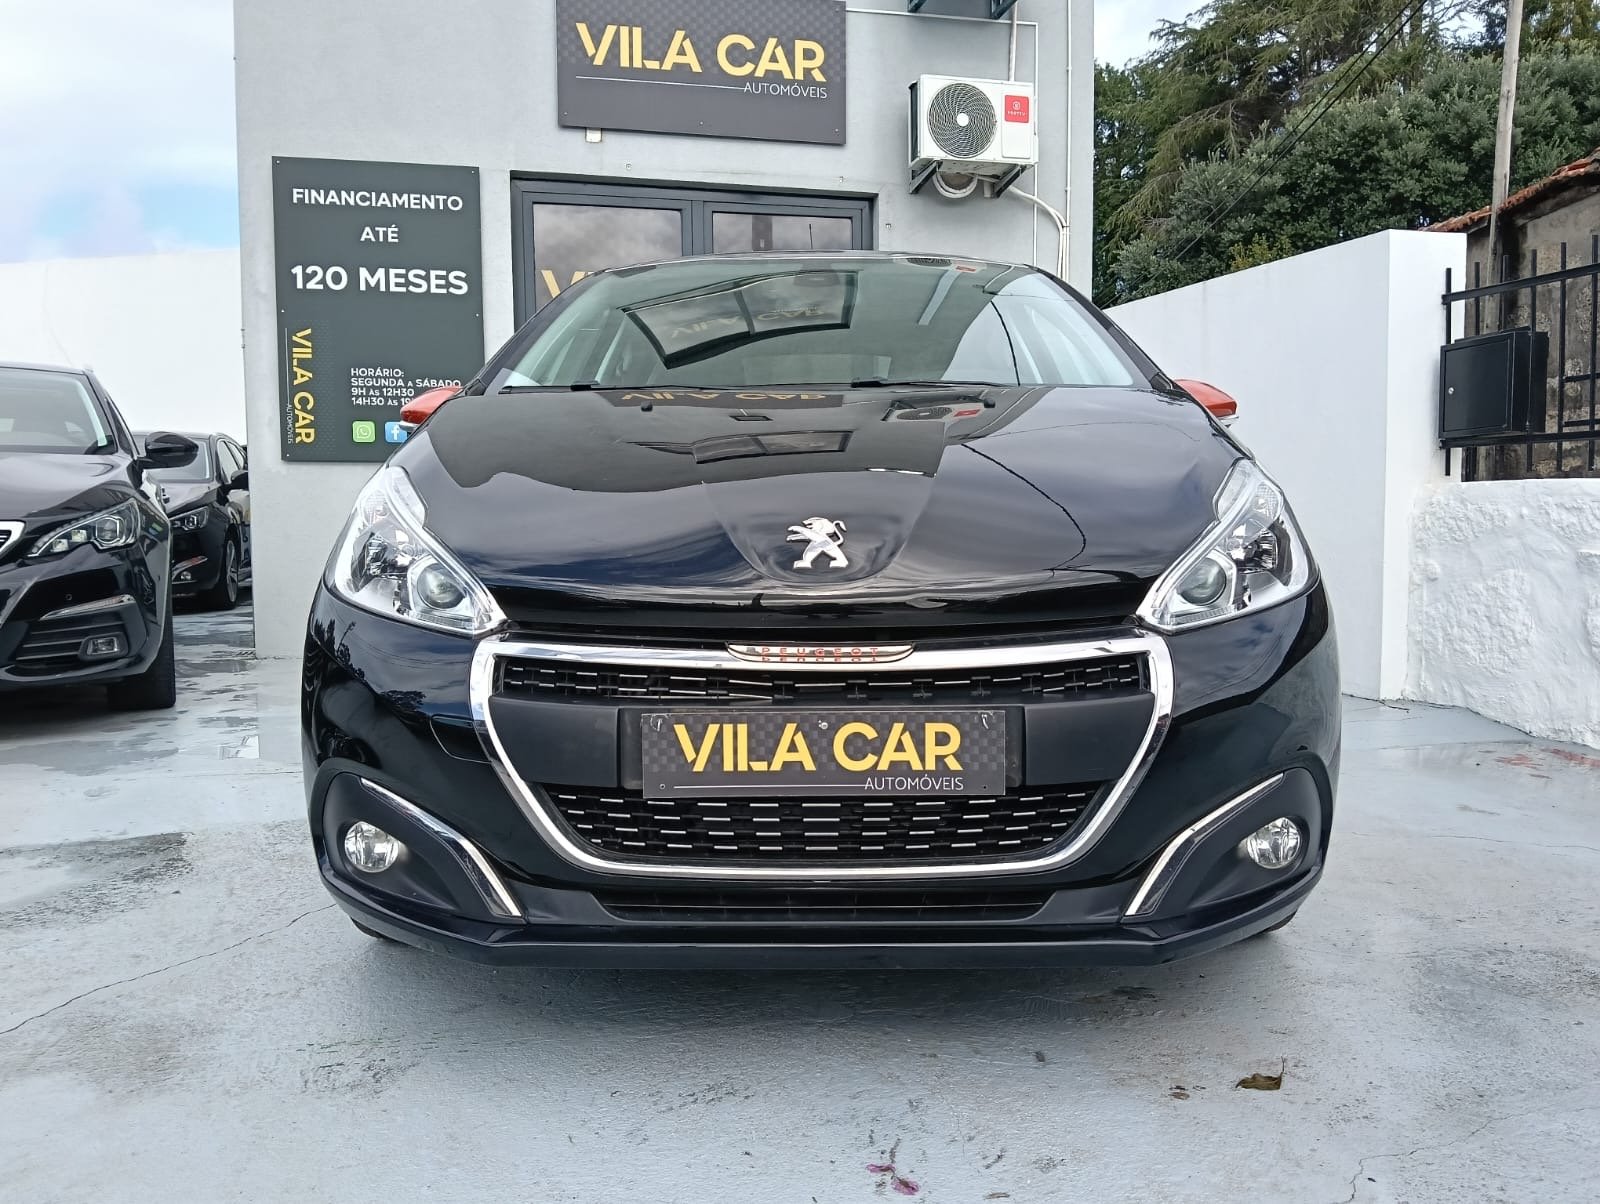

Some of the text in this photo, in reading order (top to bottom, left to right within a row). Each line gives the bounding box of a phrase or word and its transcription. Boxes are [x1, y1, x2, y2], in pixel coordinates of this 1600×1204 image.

[575, 22, 827, 82] VILA CAR
[744, 82, 828, 99] AUTOMÓVEIS
[291, 188, 464, 211] FINANCIAMENTO
[360, 224, 400, 243] ATÉ
[290, 265, 469, 295] 120 MESES
[351, 367, 405, 377] HORÁRIO:
[292, 328, 315, 444] VILA CAR
[351, 378, 405, 387] SEGUNDA
[416, 378, 461, 388] SÁBADO
[351, 388, 366, 396] 9H
[383, 388, 415, 397] 12H30
[351, 397, 385, 406] 14H30
[761, 647, 879, 656] PEUGEOT
[673, 722, 963, 772] VILA CAR
[864, 774, 964, 791] AUTOMÓVEIS
